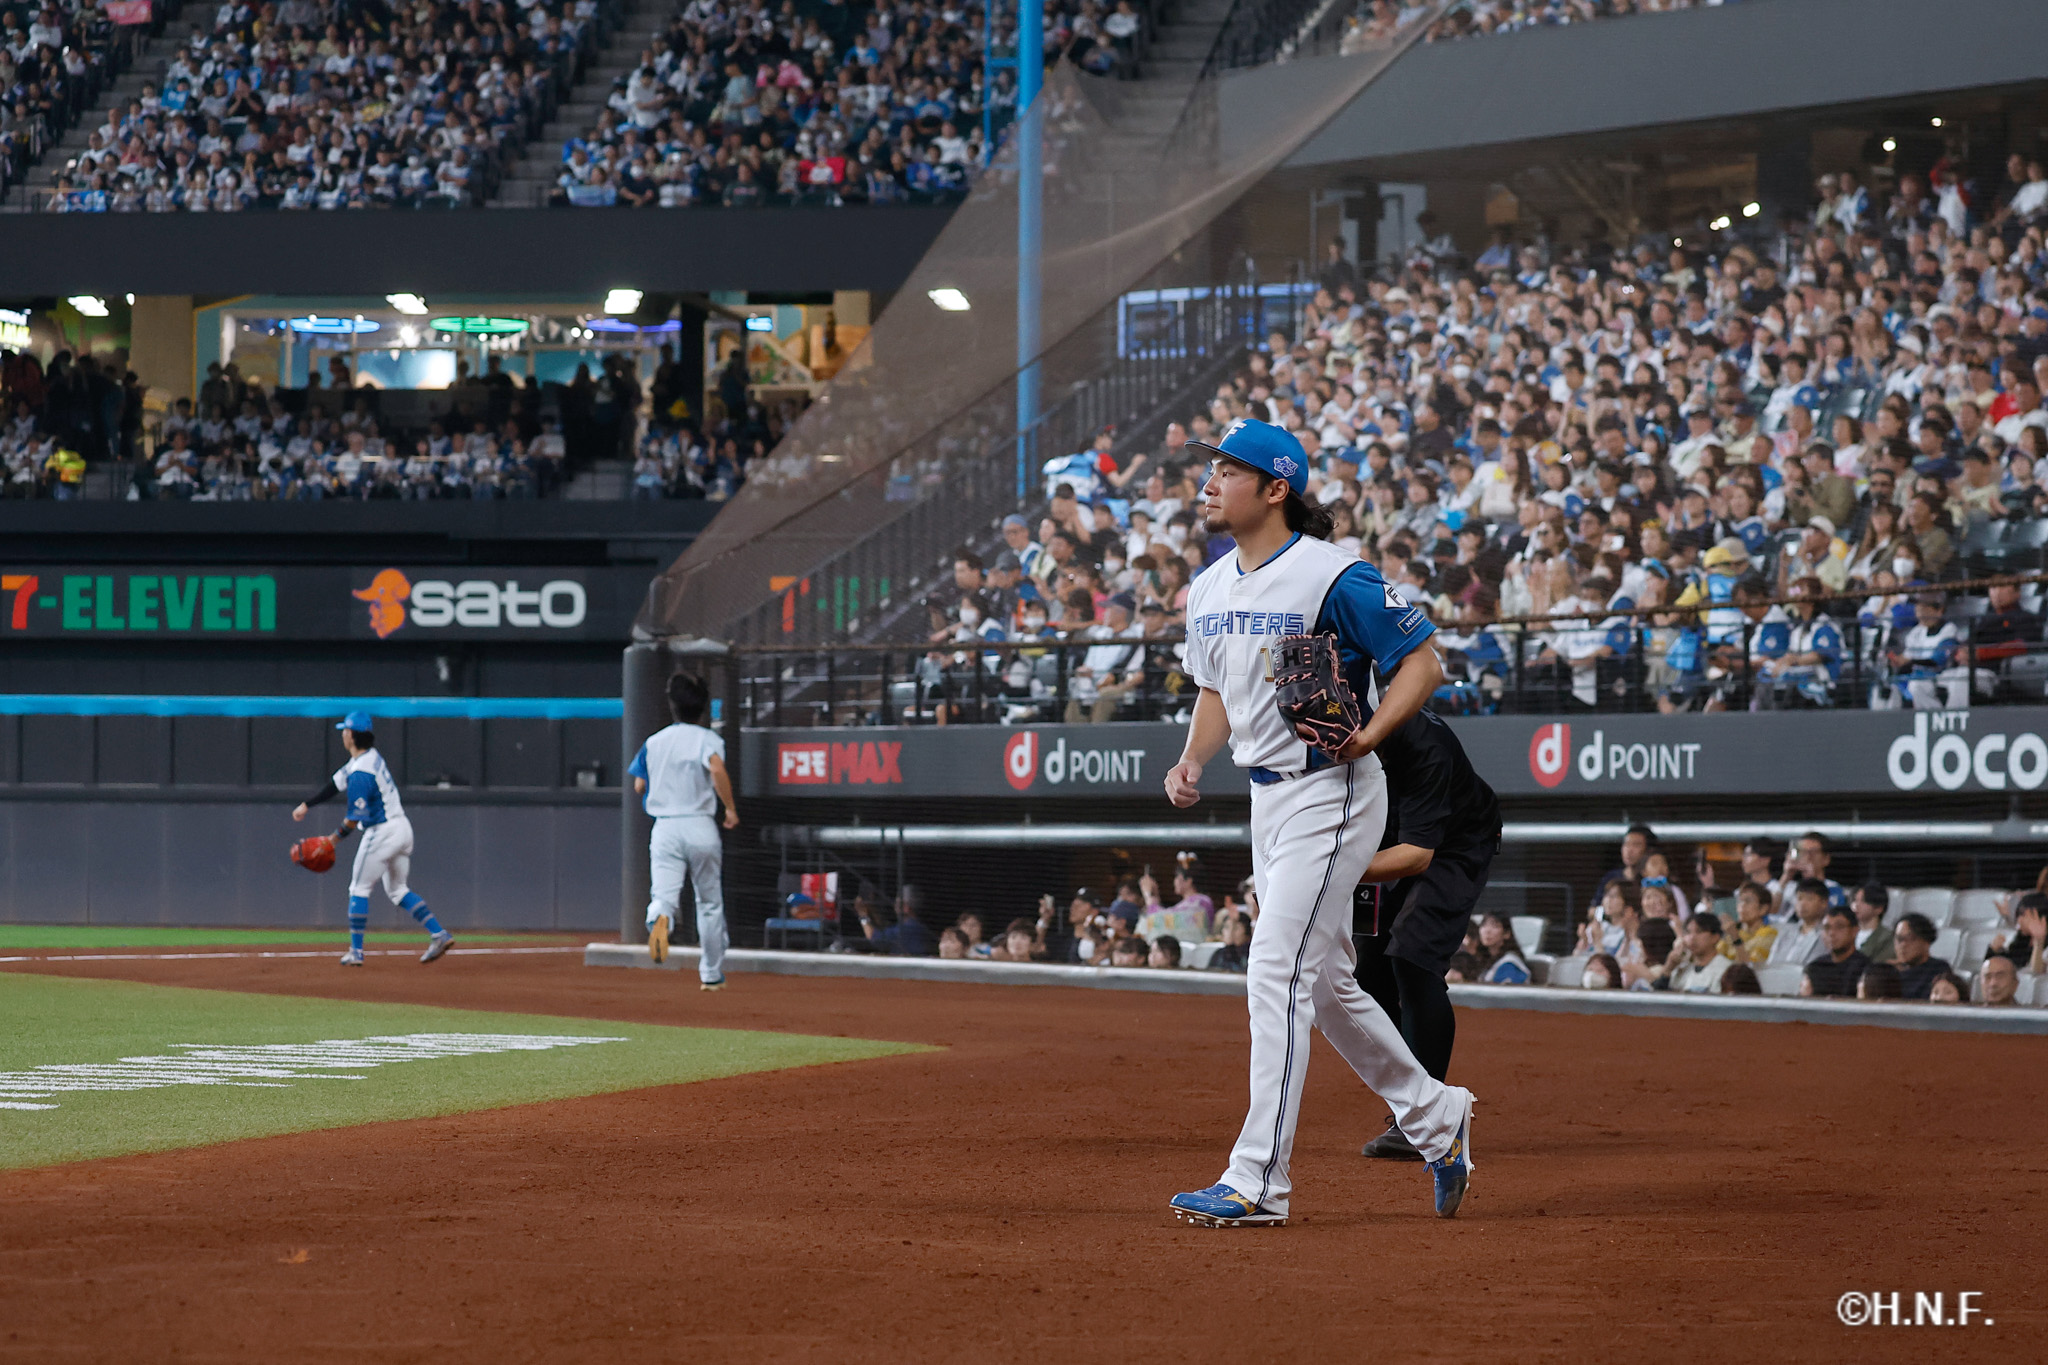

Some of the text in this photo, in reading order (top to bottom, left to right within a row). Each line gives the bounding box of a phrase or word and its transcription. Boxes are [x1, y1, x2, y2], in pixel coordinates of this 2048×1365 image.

[410, 580, 587, 627] sato
[1194, 611, 1304, 637] FIGHTERS
[1932, 711, 1970, 731] NTT
[831, 742, 902, 784] MAX
[1070, 750, 1145, 783] POINT
[1610, 744, 1700, 780] POINT
